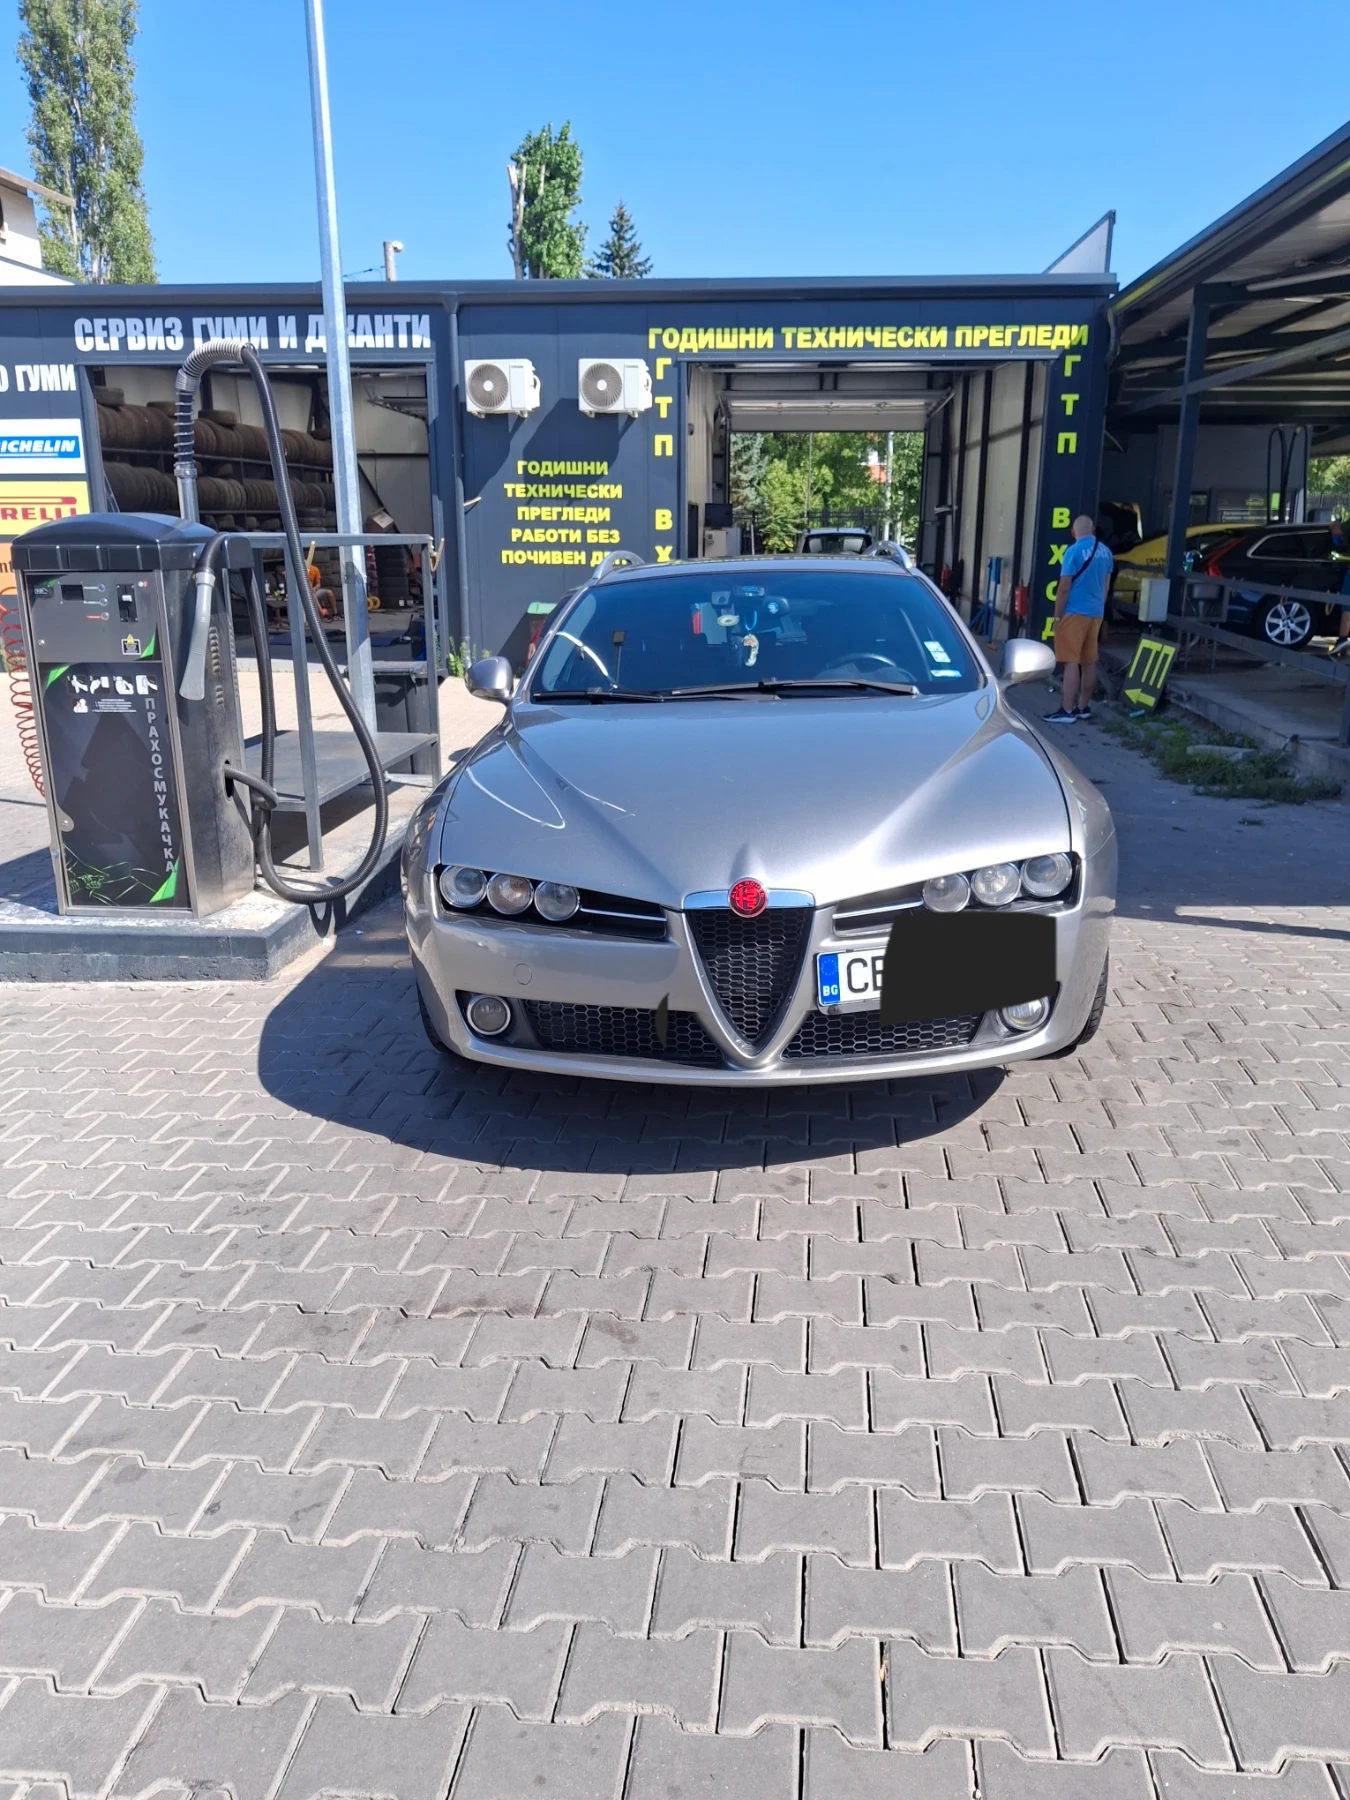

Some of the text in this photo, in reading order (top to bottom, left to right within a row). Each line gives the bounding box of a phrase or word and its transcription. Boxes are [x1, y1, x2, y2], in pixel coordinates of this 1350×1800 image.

[74, 317, 185, 352] СЕРВИЗ
[192, 316, 269, 350] ГУМИ
[278, 315, 298, 349] И
[649, 324, 1089, 353] ГОДИШНИ ТЕХНИЧЕСКИ ПРЕГЛЕДИ
[15, 364, 77, 392] ГУМИ
[654, 357, 673, 457] ГТП
[1056, 355, 1080, 454] ГТП
[0, 440, 76, 453] ICHELIN
[517, 460, 609, 477] ГОДИШНИ
[504, 483, 623, 499] ТЕХНИЧЕСКИ
[517, 506, 611, 524] ПРЕГЛЕДИ
[511, 528, 621, 544] РАБОТИ БЕЗ
[501, 550, 587, 565] ПОЧИВЕН
[1128, 638, 1176, 689] ГТП
[145, 697, 175, 873] ПРАХОСМУКАЧКА
[823, 984, 839, 997] BG
